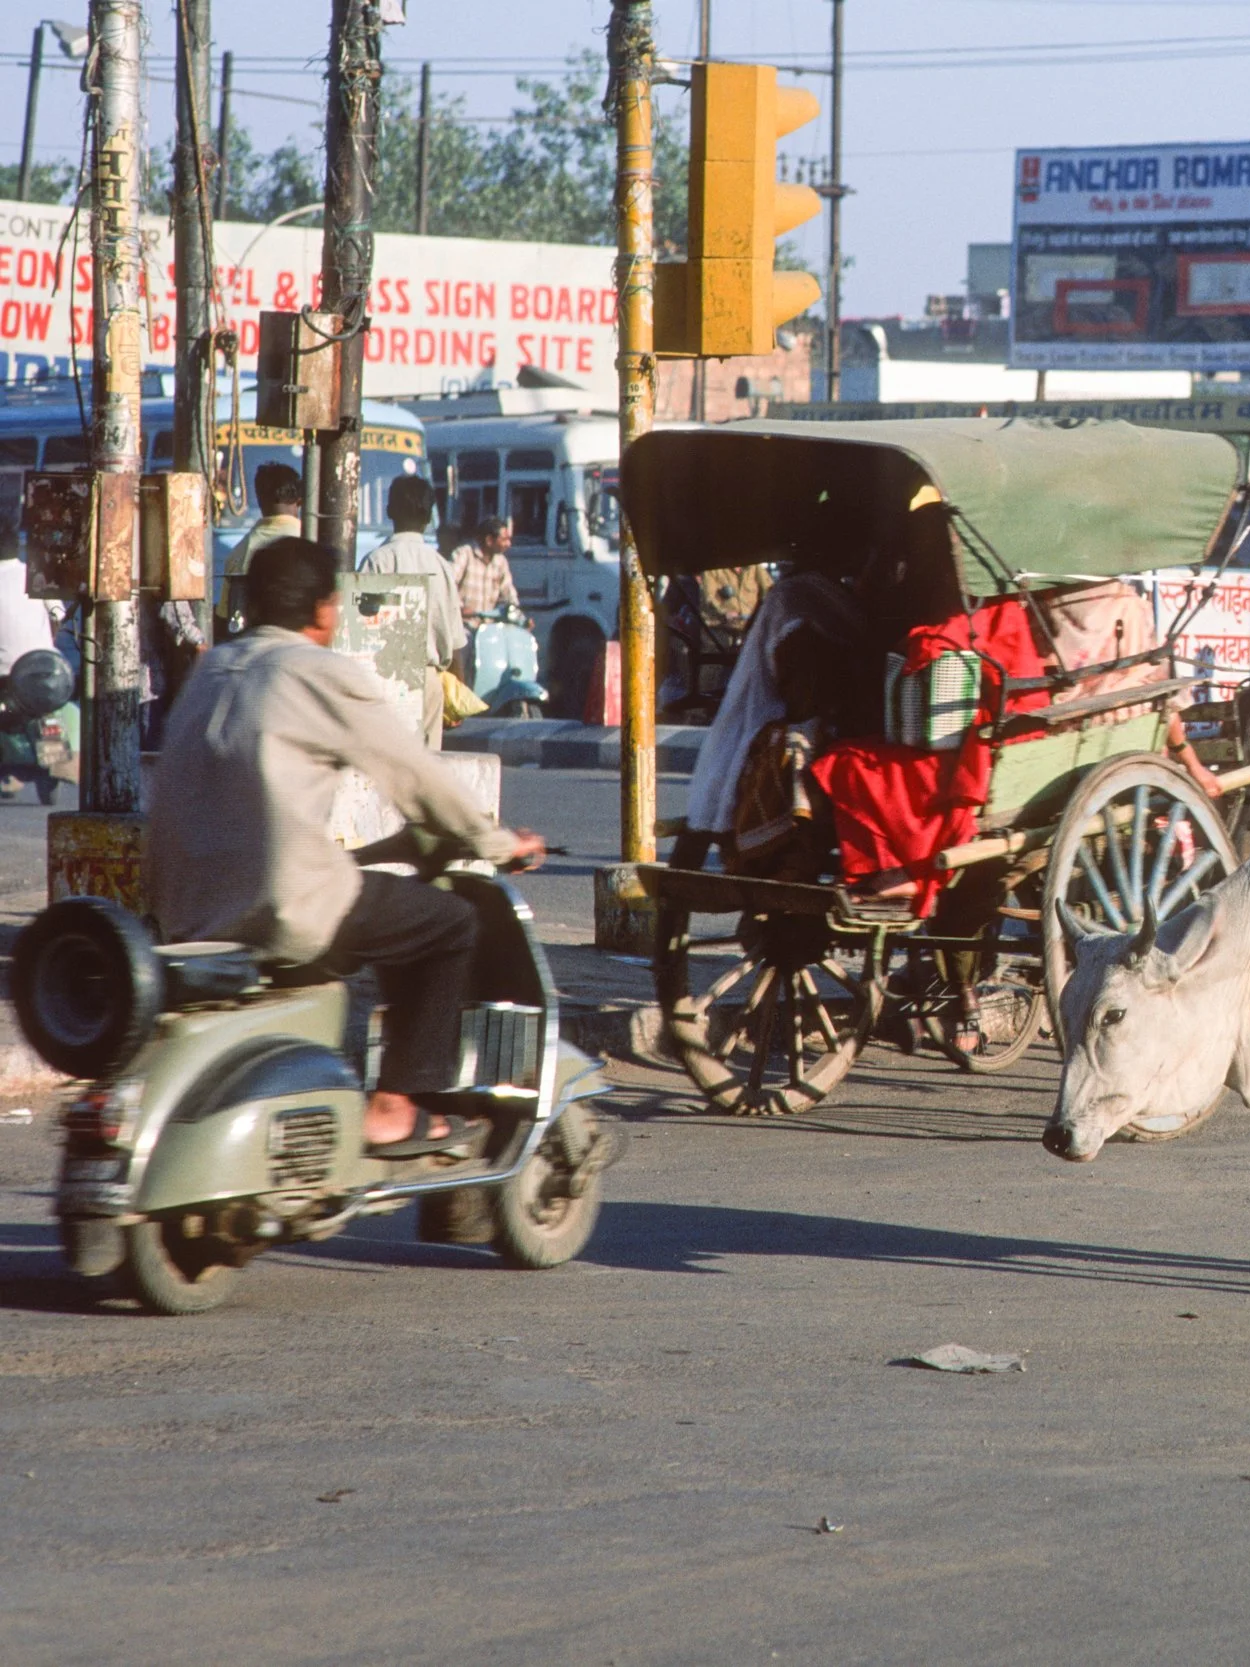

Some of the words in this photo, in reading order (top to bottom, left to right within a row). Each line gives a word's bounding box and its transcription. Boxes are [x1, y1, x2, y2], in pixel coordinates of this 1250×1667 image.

[1044, 157, 1159, 192] ANCHOR
[424, 280, 497, 320] SIGN
[362, 327, 497, 369] ORDING
[516, 334, 594, 374] SITE
